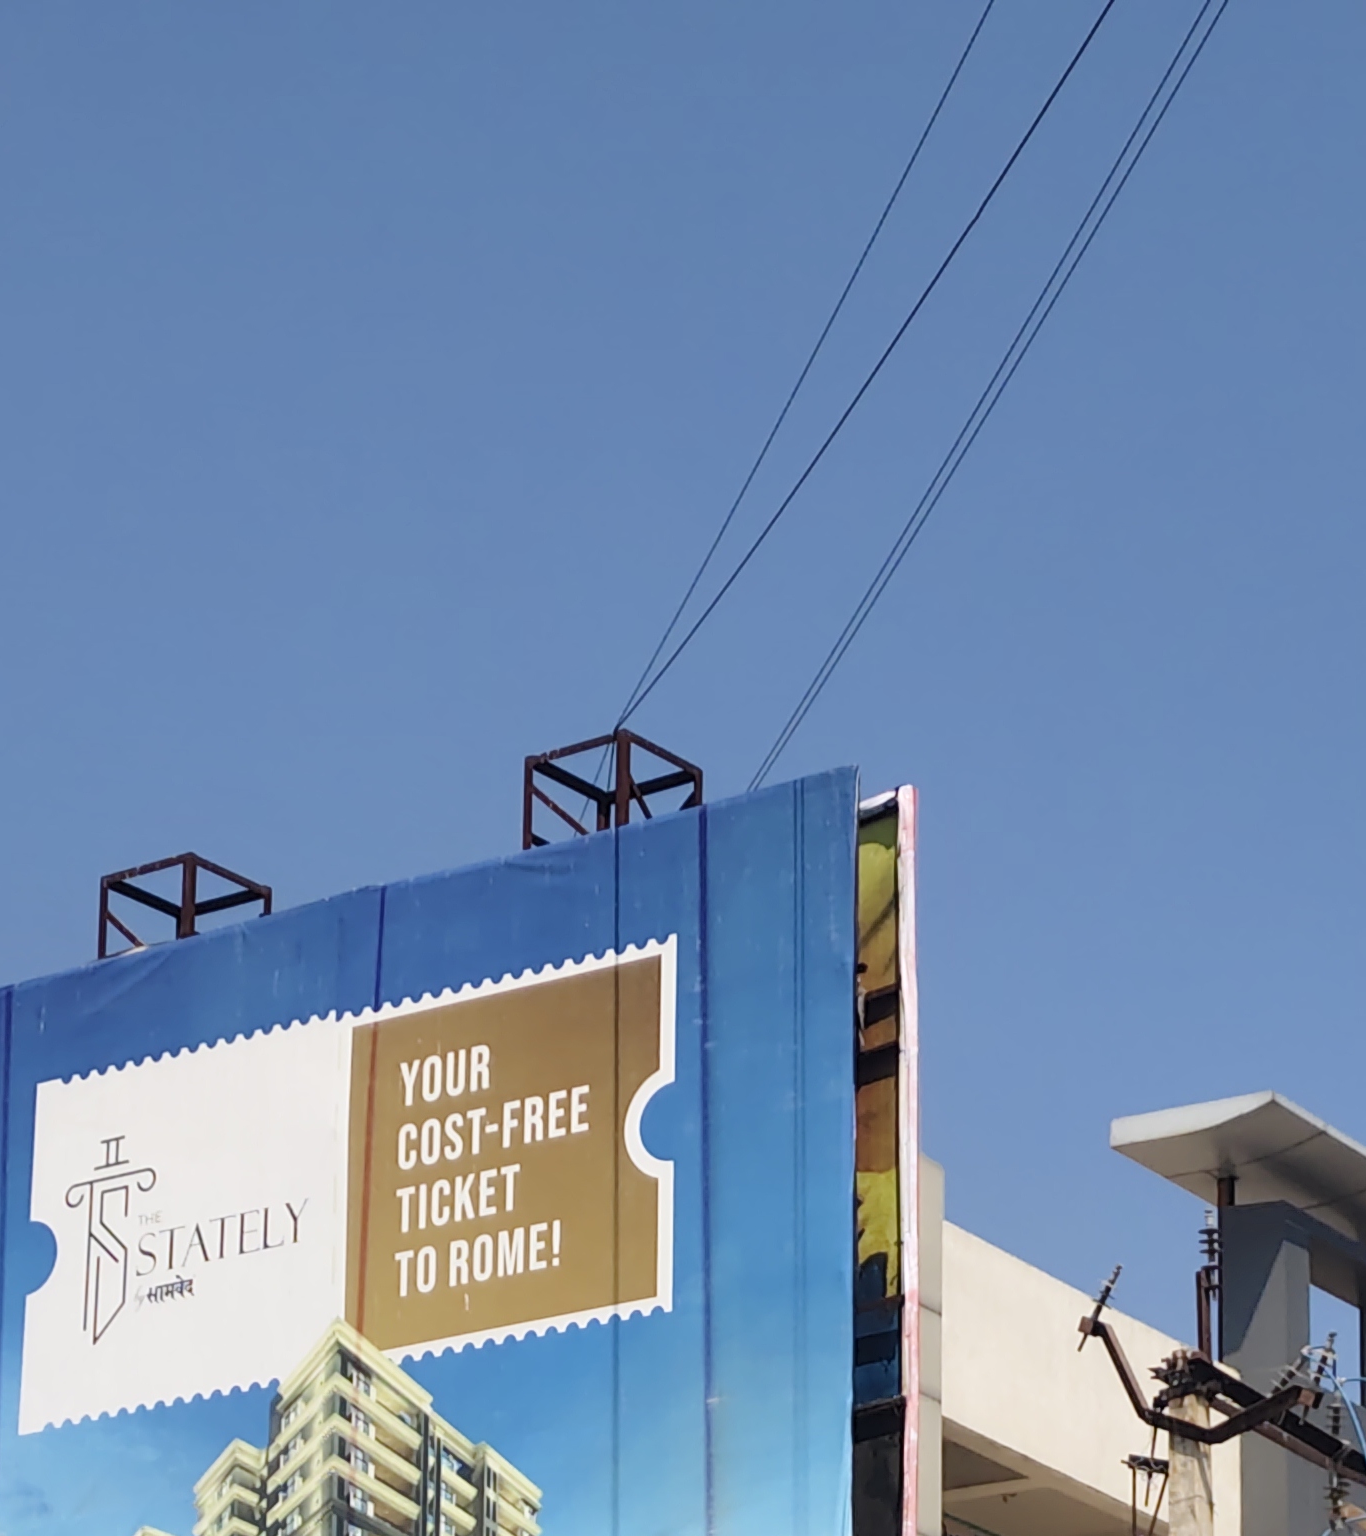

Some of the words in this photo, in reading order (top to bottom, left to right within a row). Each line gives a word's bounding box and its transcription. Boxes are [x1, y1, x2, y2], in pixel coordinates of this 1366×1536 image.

[400, 1045, 490, 1106] YOUR
[397, 1084, 590, 1171] COST-FREE
[138, 1210, 162, 1225] THE
[396, 1164, 520, 1233] TICKET
[136, 1198, 309, 1276] STATELY
[395, 1251, 434, 1297] TO
[449, 1221, 561, 1286] ROME!
